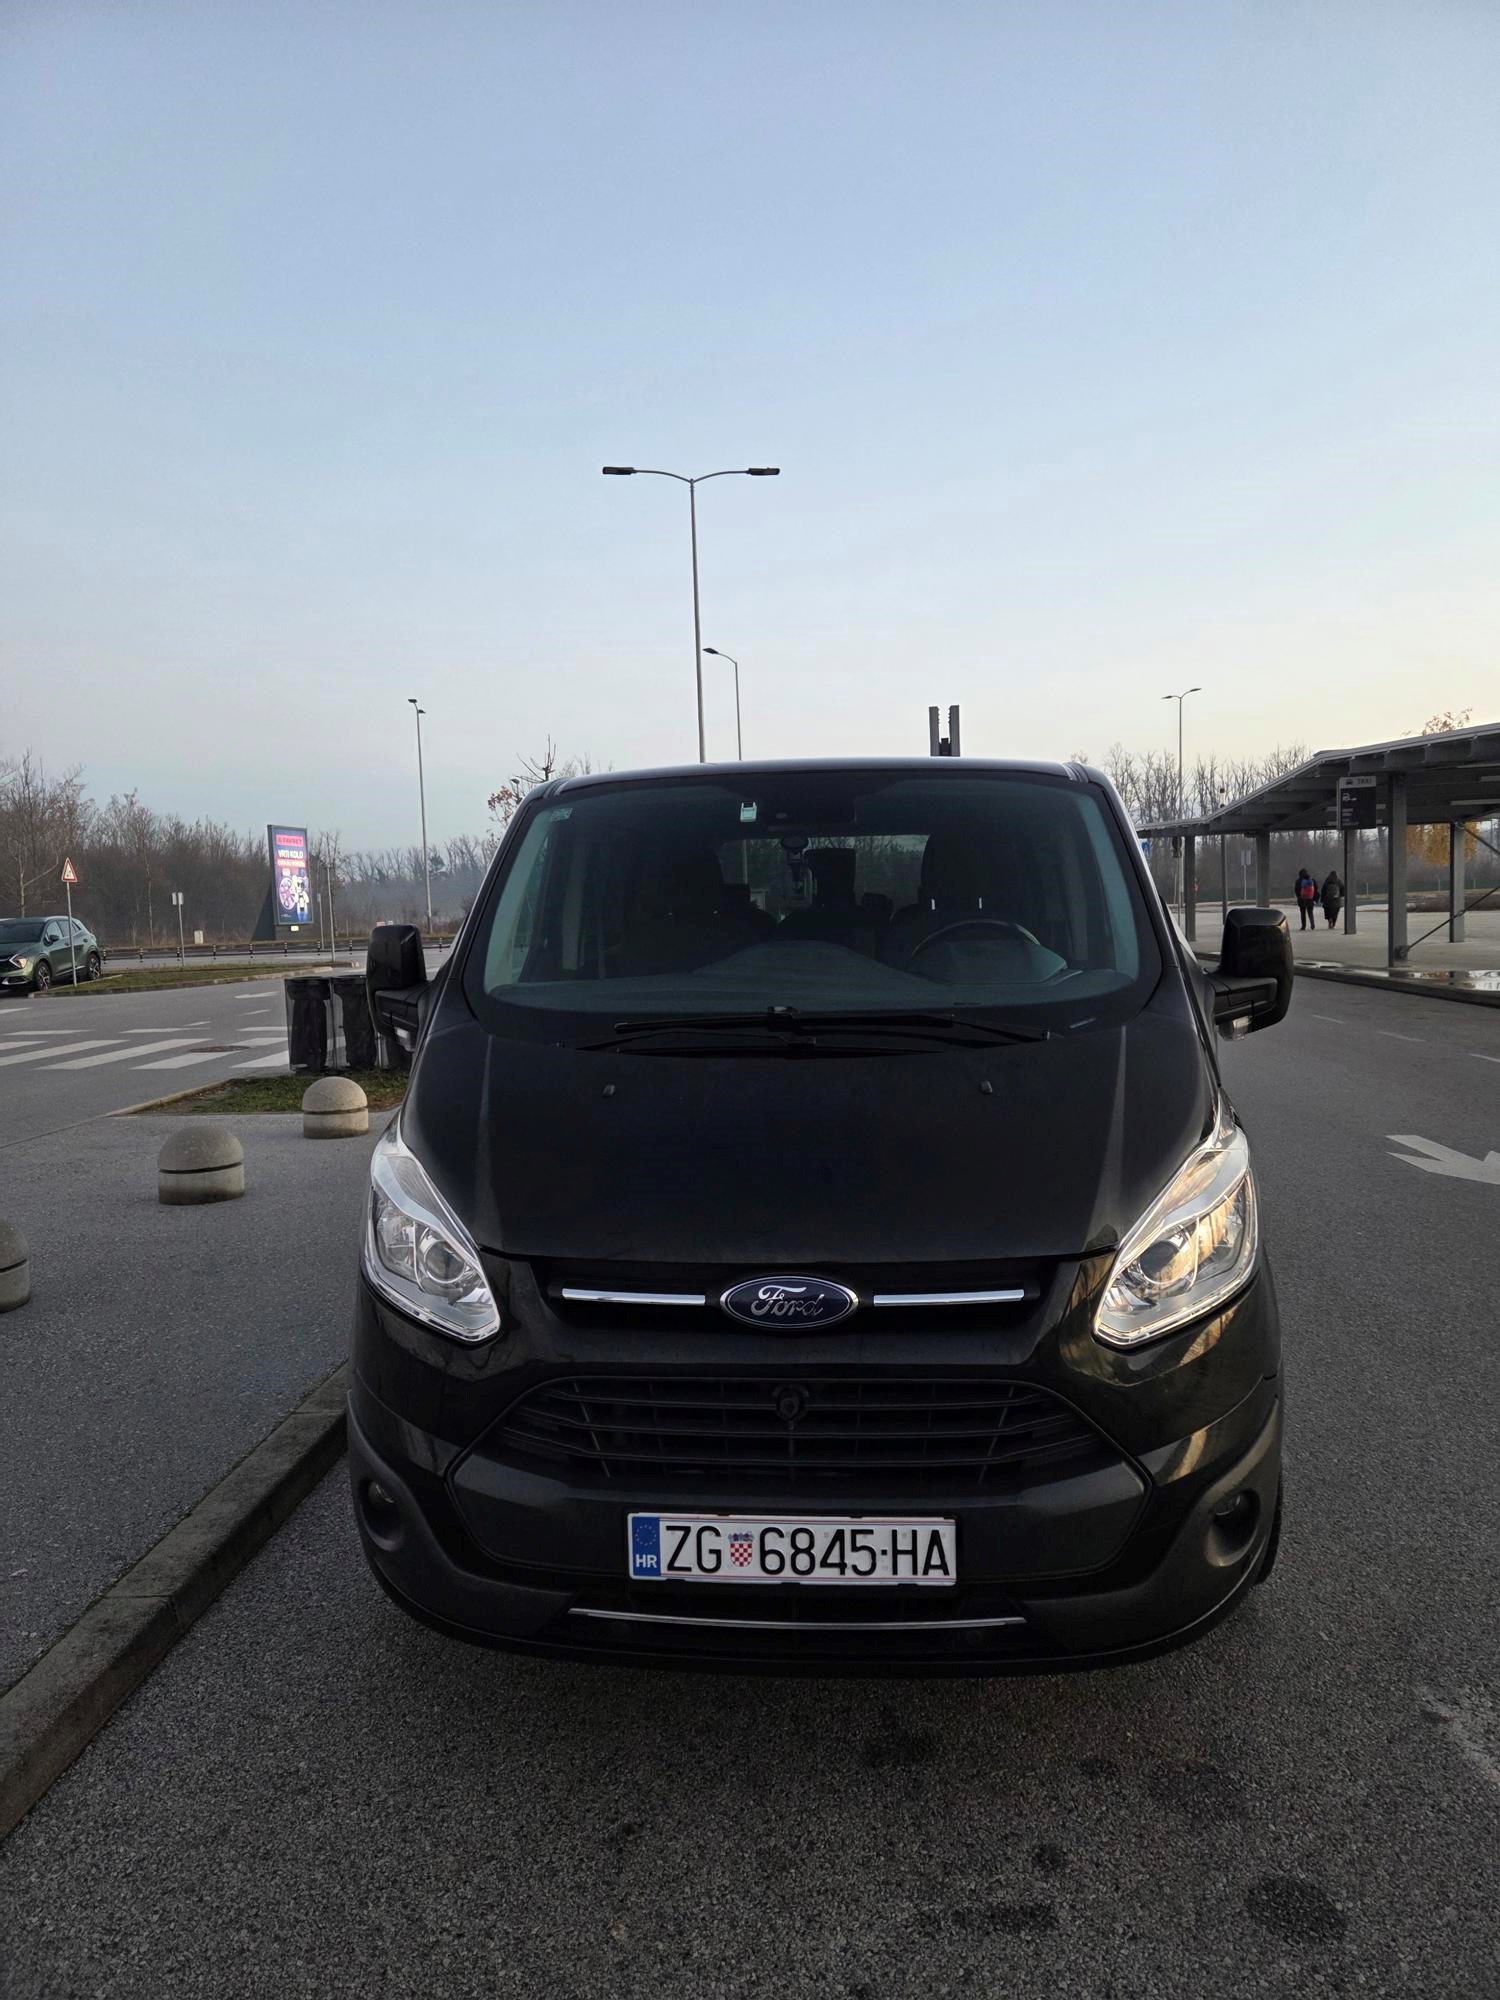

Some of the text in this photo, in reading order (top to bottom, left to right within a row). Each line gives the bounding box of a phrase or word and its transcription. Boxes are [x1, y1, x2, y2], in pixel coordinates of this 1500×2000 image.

[750, 1285, 824, 1317] Ford
[635, 1554, 658, 1569] HR
[666, 1525, 722, 1574] ZG
